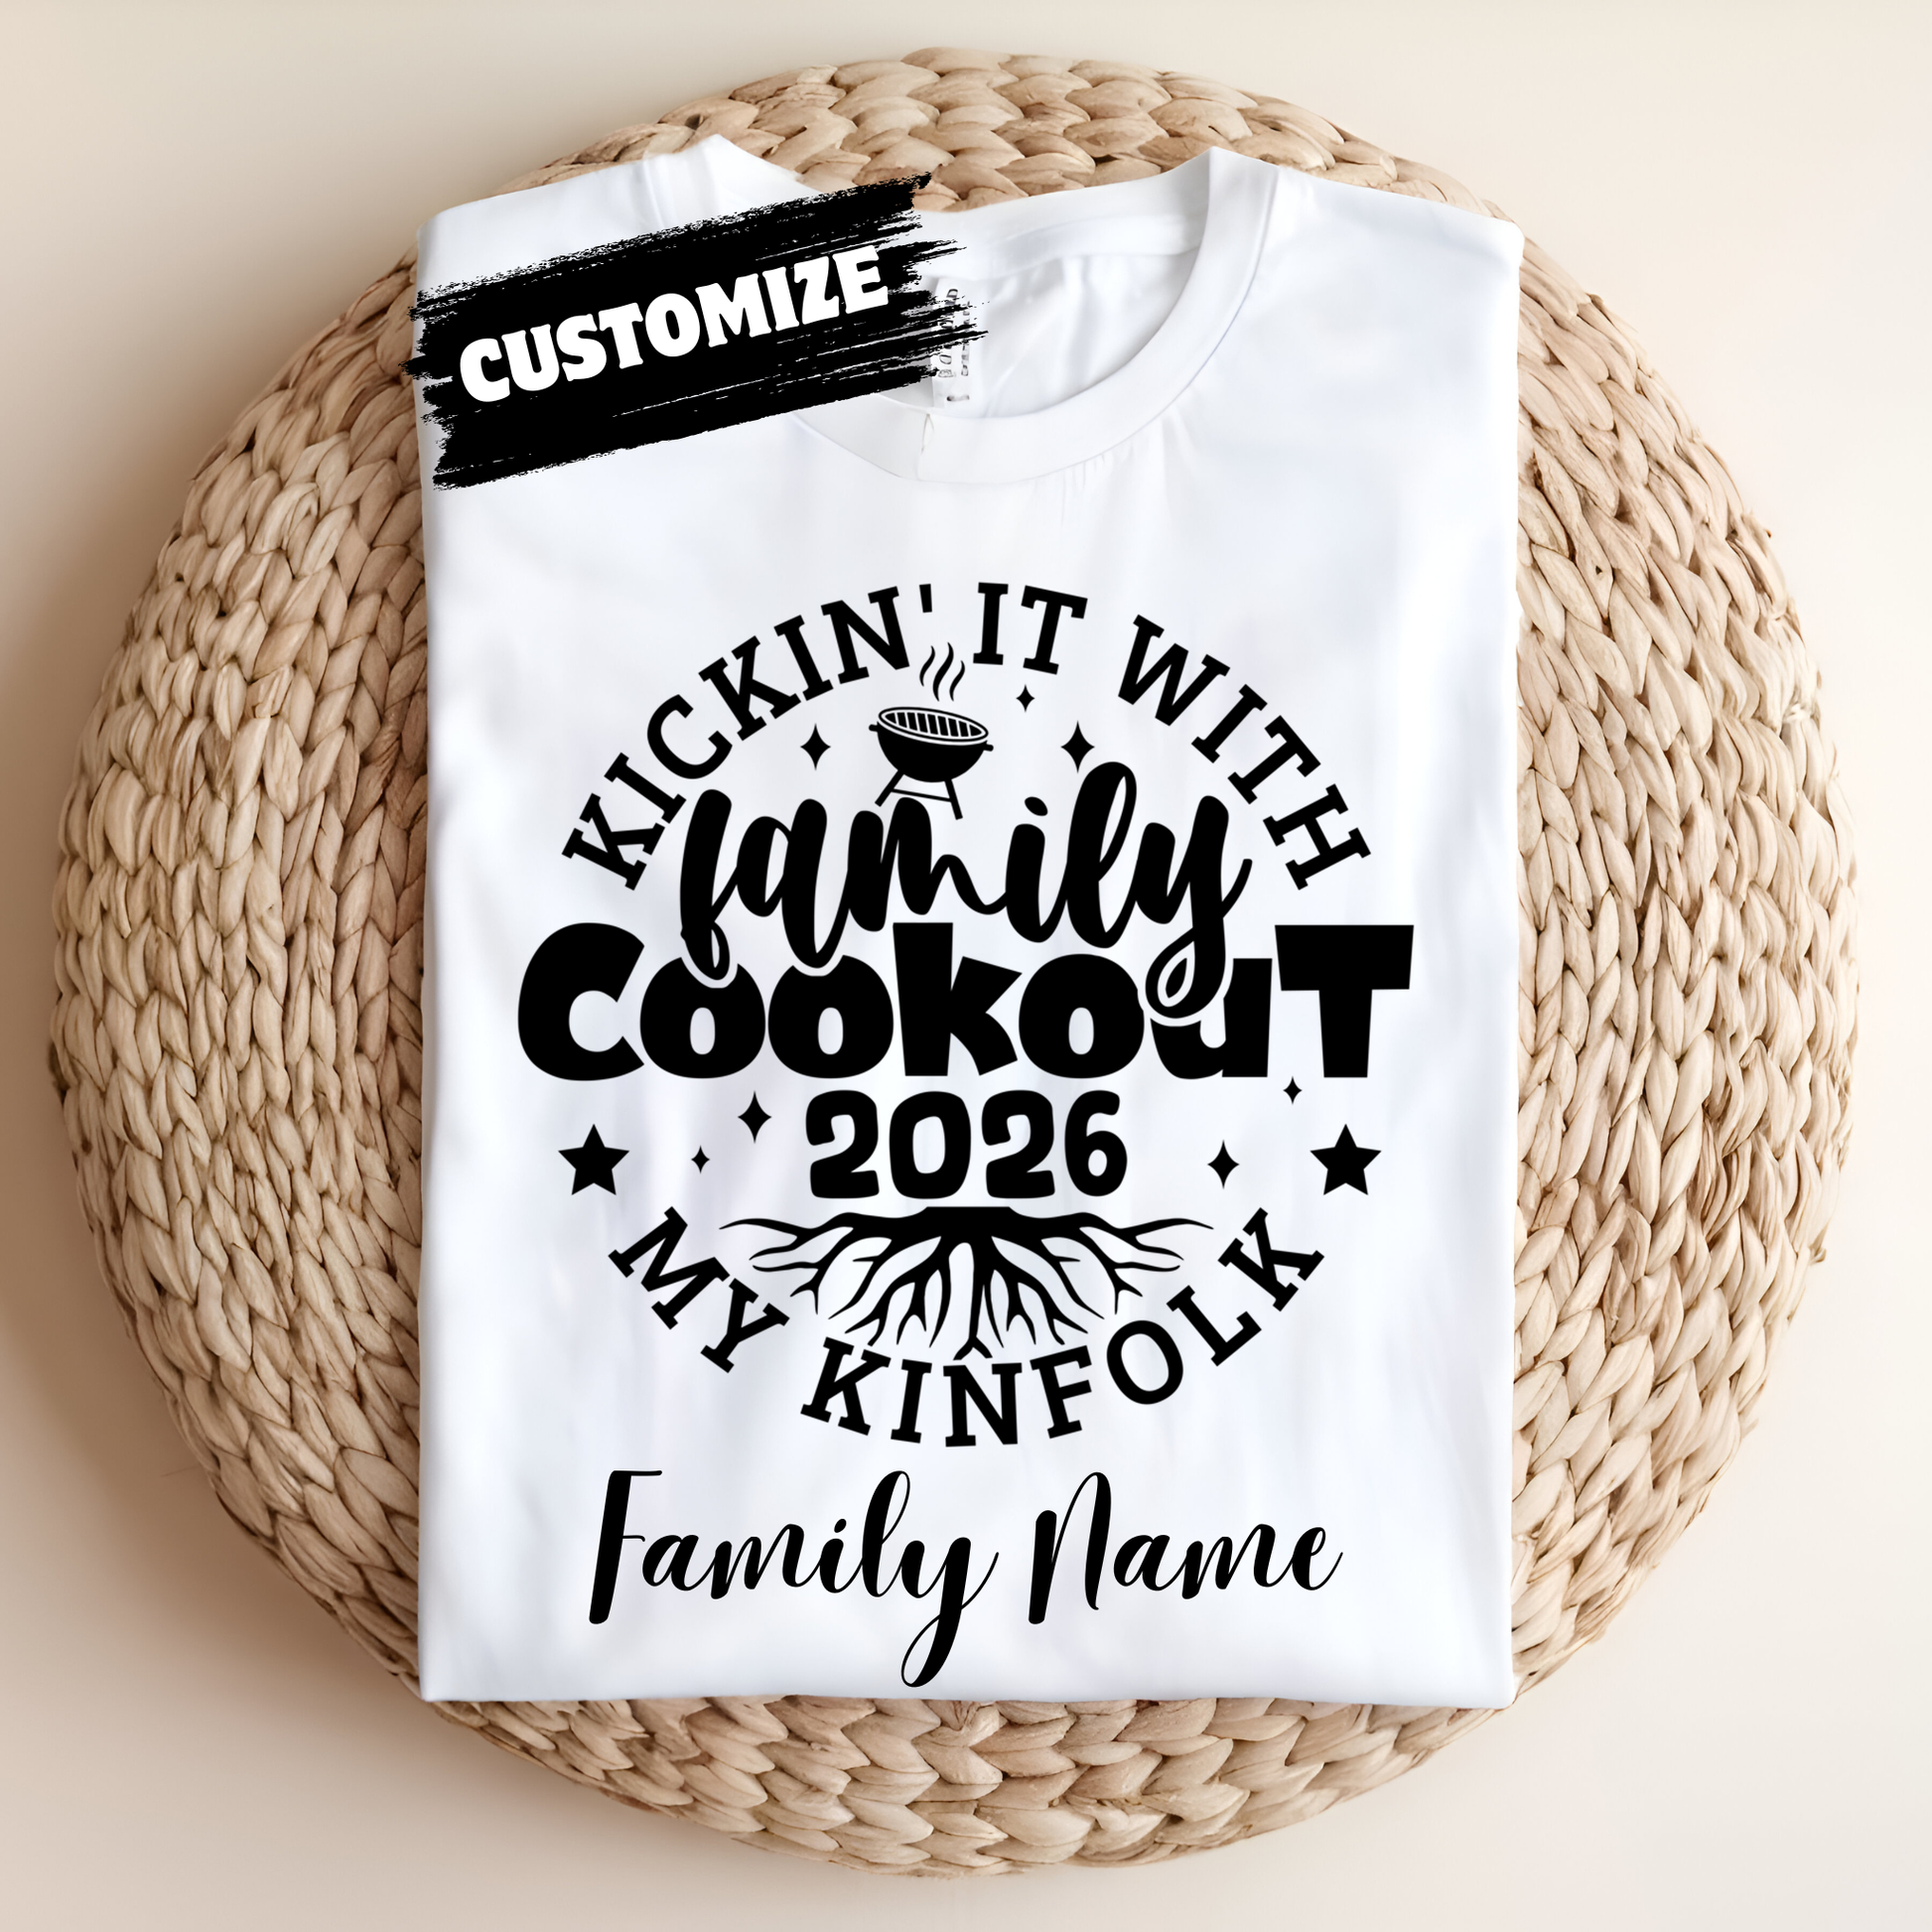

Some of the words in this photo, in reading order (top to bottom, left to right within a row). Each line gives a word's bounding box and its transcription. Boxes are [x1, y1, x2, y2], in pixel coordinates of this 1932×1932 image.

[562, 583, 932, 891] KICKIN'
[973, 583, 1087, 675] IT
[1118, 615, 1370, 890] WITH
[680, 761, 1252, 1019] family
[806, 1090, 1127, 1199] 2026
[609, 1207, 789, 1373] MY
[801, 1208, 1324, 1447] KINFOLK
[590, 1470, 999, 1687] Family
[1029, 1472, 1342, 1624] Name
